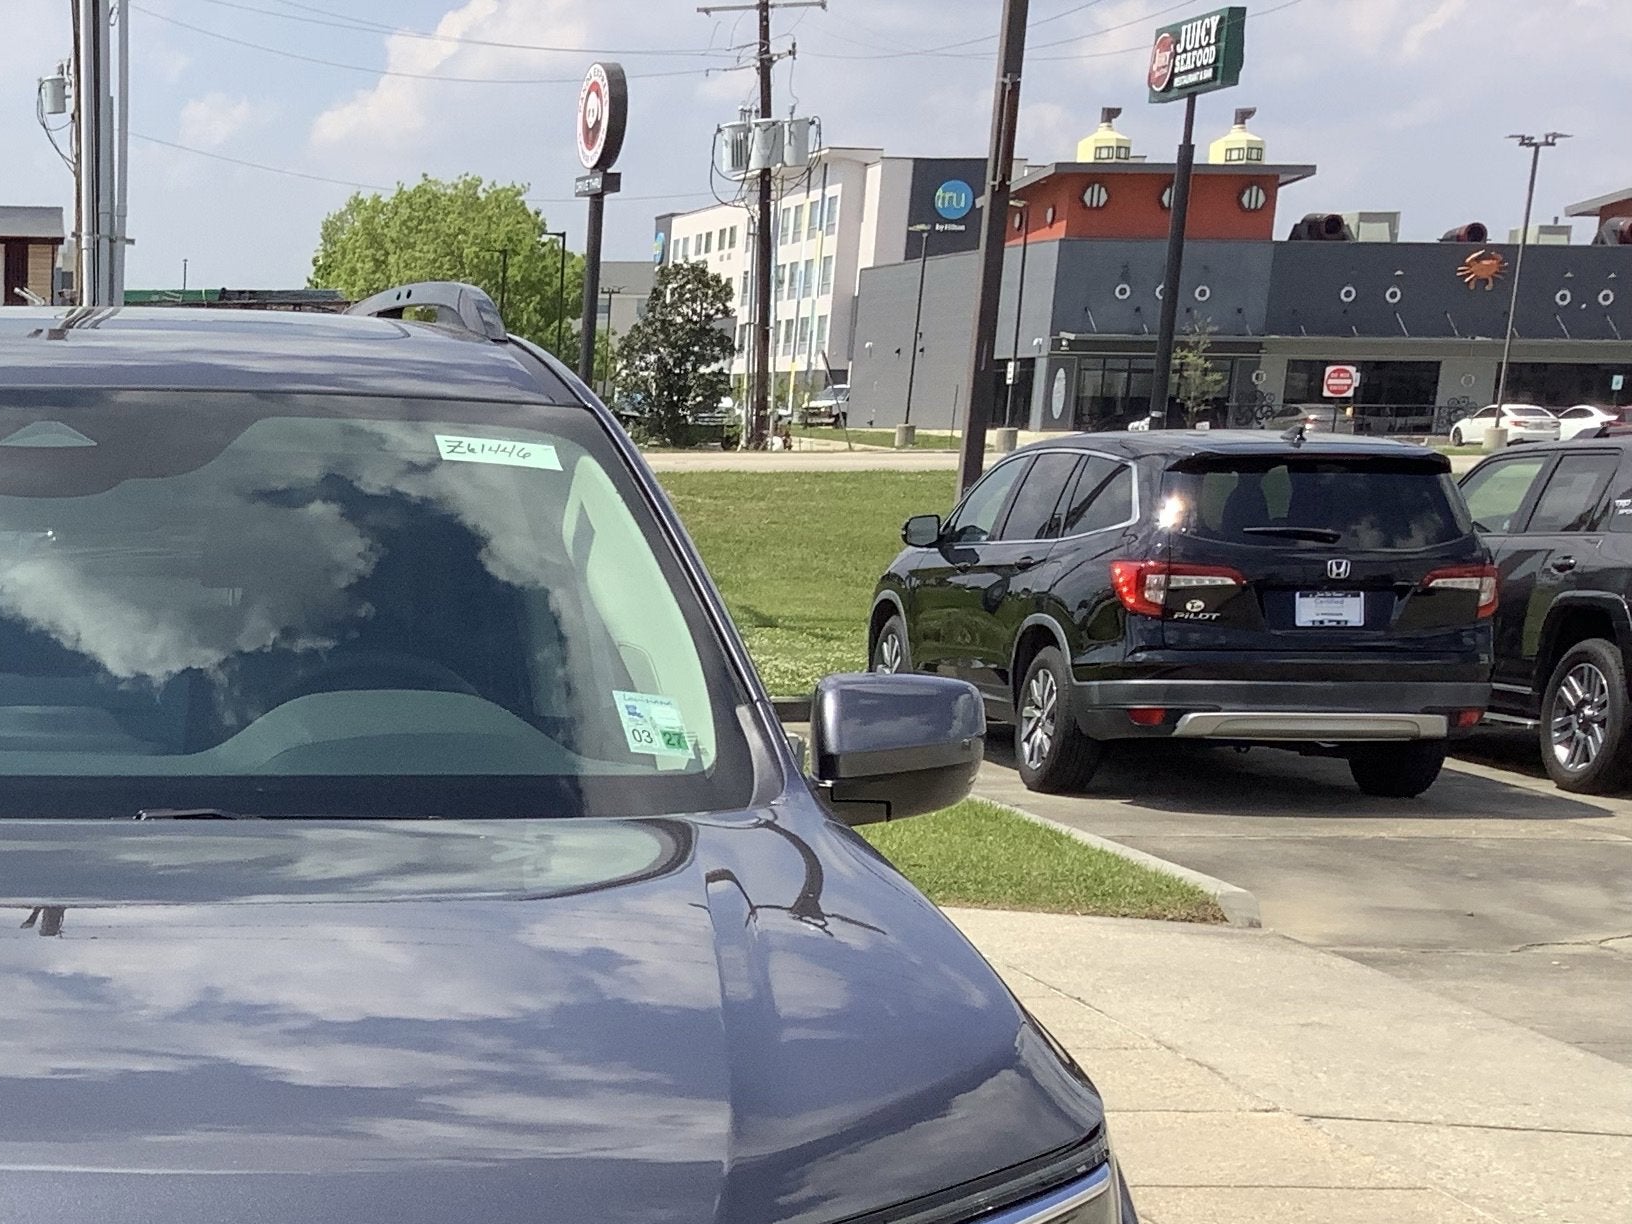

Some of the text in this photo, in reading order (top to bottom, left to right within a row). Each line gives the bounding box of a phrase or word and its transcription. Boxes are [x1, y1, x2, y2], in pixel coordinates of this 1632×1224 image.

[1176, 15, 1220, 53] JUICY
[1174, 45, 1216, 73] SEAFOOD
[937, 187, 966, 208] tru
[1173, 611, 1221, 621] PILOT
[631, 728, 683, 747] 03 27
